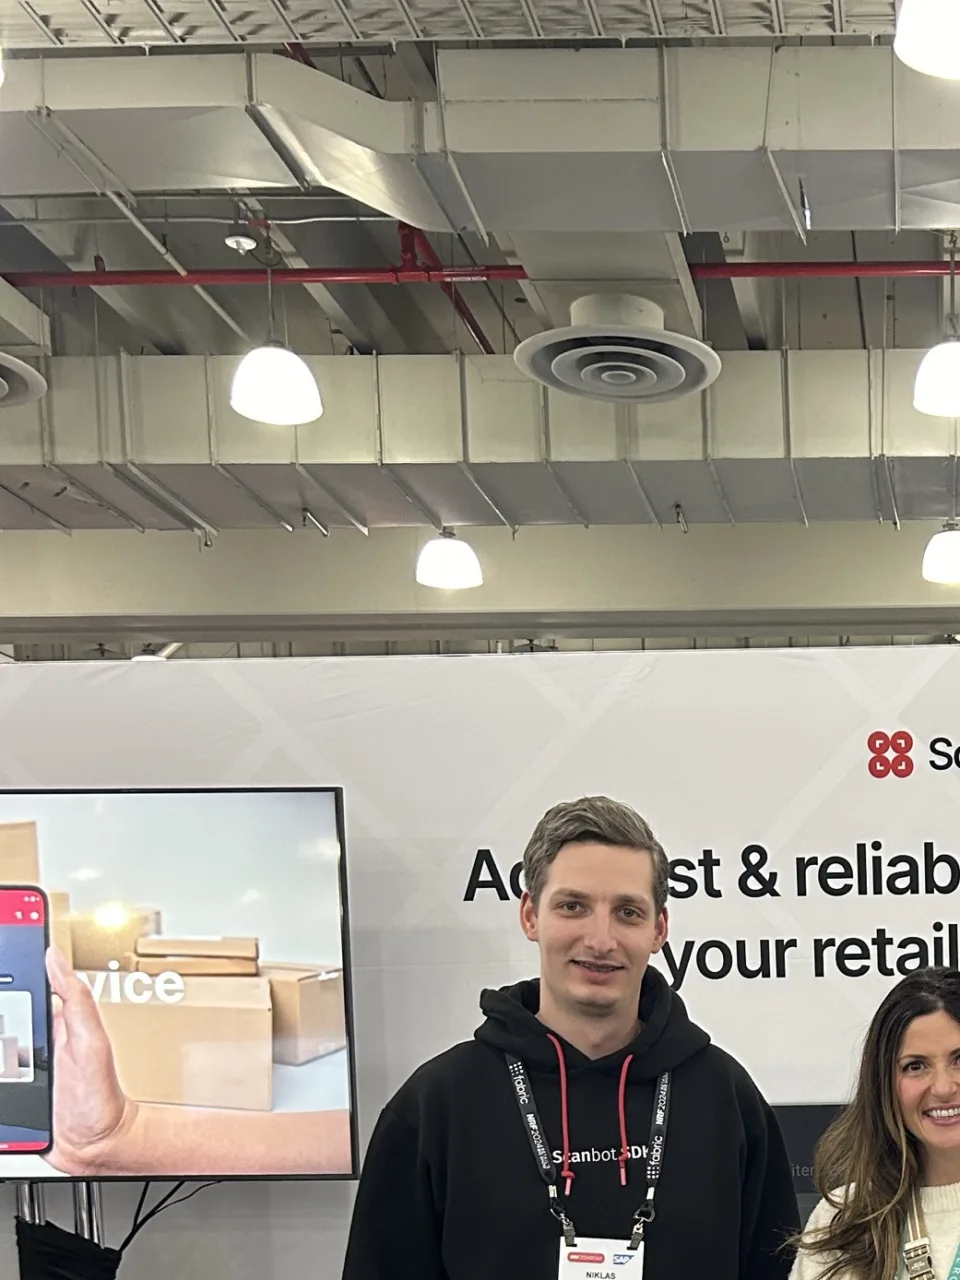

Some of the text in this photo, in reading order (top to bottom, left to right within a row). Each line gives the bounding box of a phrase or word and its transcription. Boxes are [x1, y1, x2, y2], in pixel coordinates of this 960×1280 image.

[669, 849, 722, 898] st
[737, 844, 781, 898] &
[664, 938, 797, 992] your
[813, 921, 959, 977] retail
[76, 960, 185, 1004] vice
[513, 1075, 530, 1104] fabric
[649, 1135, 663, 1165] fabric
[586, 1271, 616, 1280] NIKLAS
